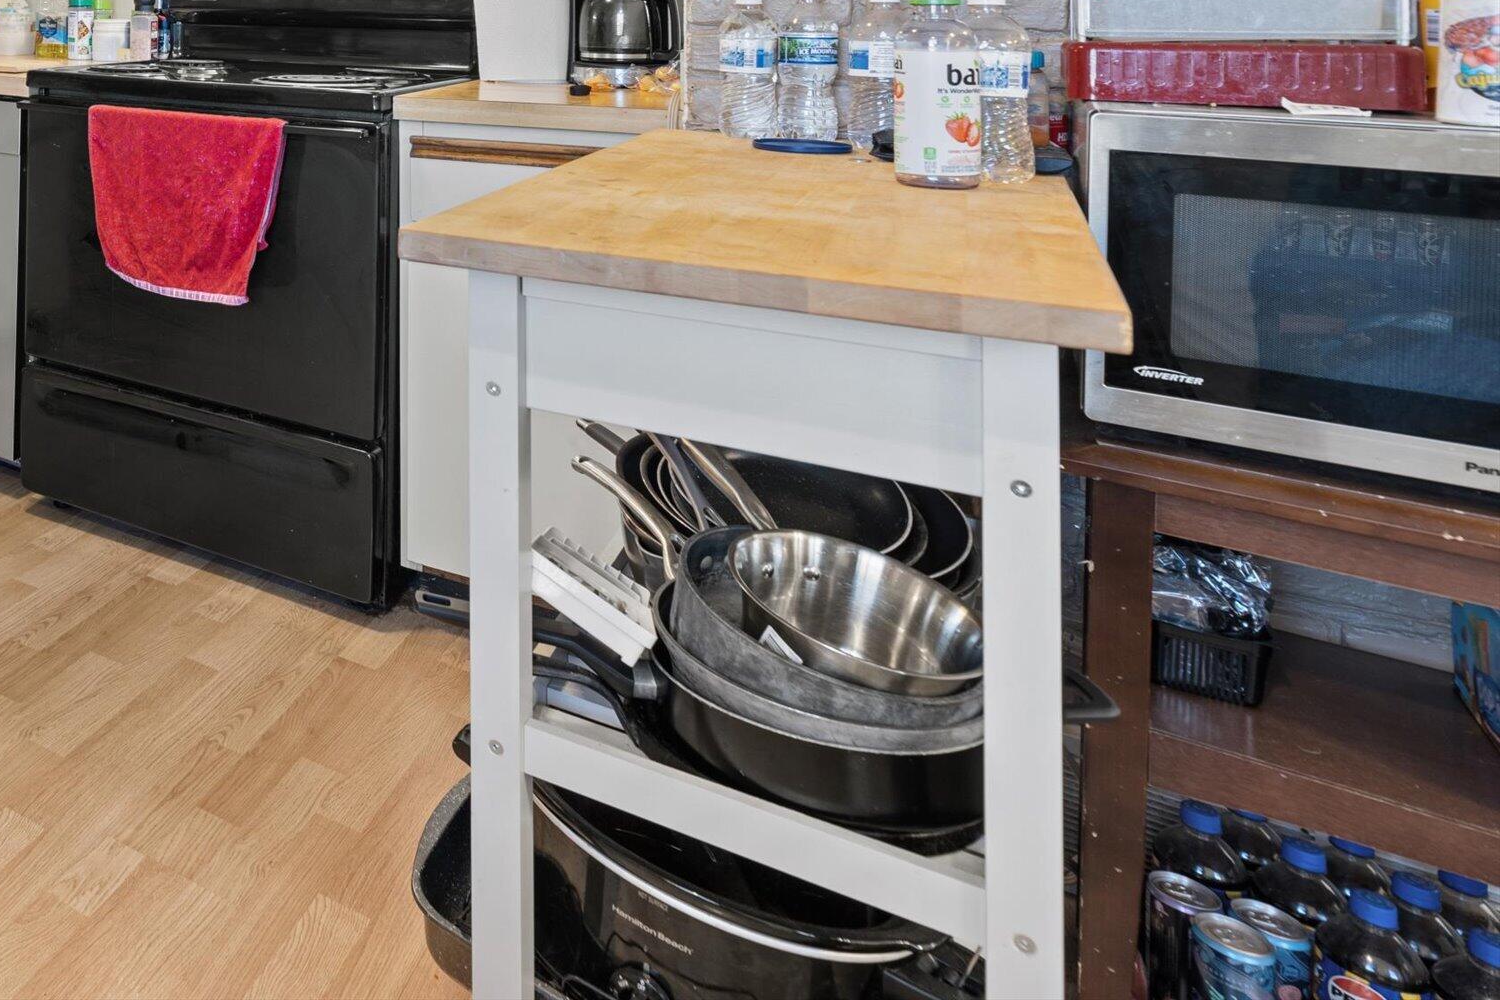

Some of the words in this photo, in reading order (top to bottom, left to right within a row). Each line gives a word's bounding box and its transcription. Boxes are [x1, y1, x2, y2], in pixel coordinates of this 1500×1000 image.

[1140, 368, 1204, 386] INVERTER
[612, 904, 657, 938] Hamilton
[658, 932, 693, 956] Beach
